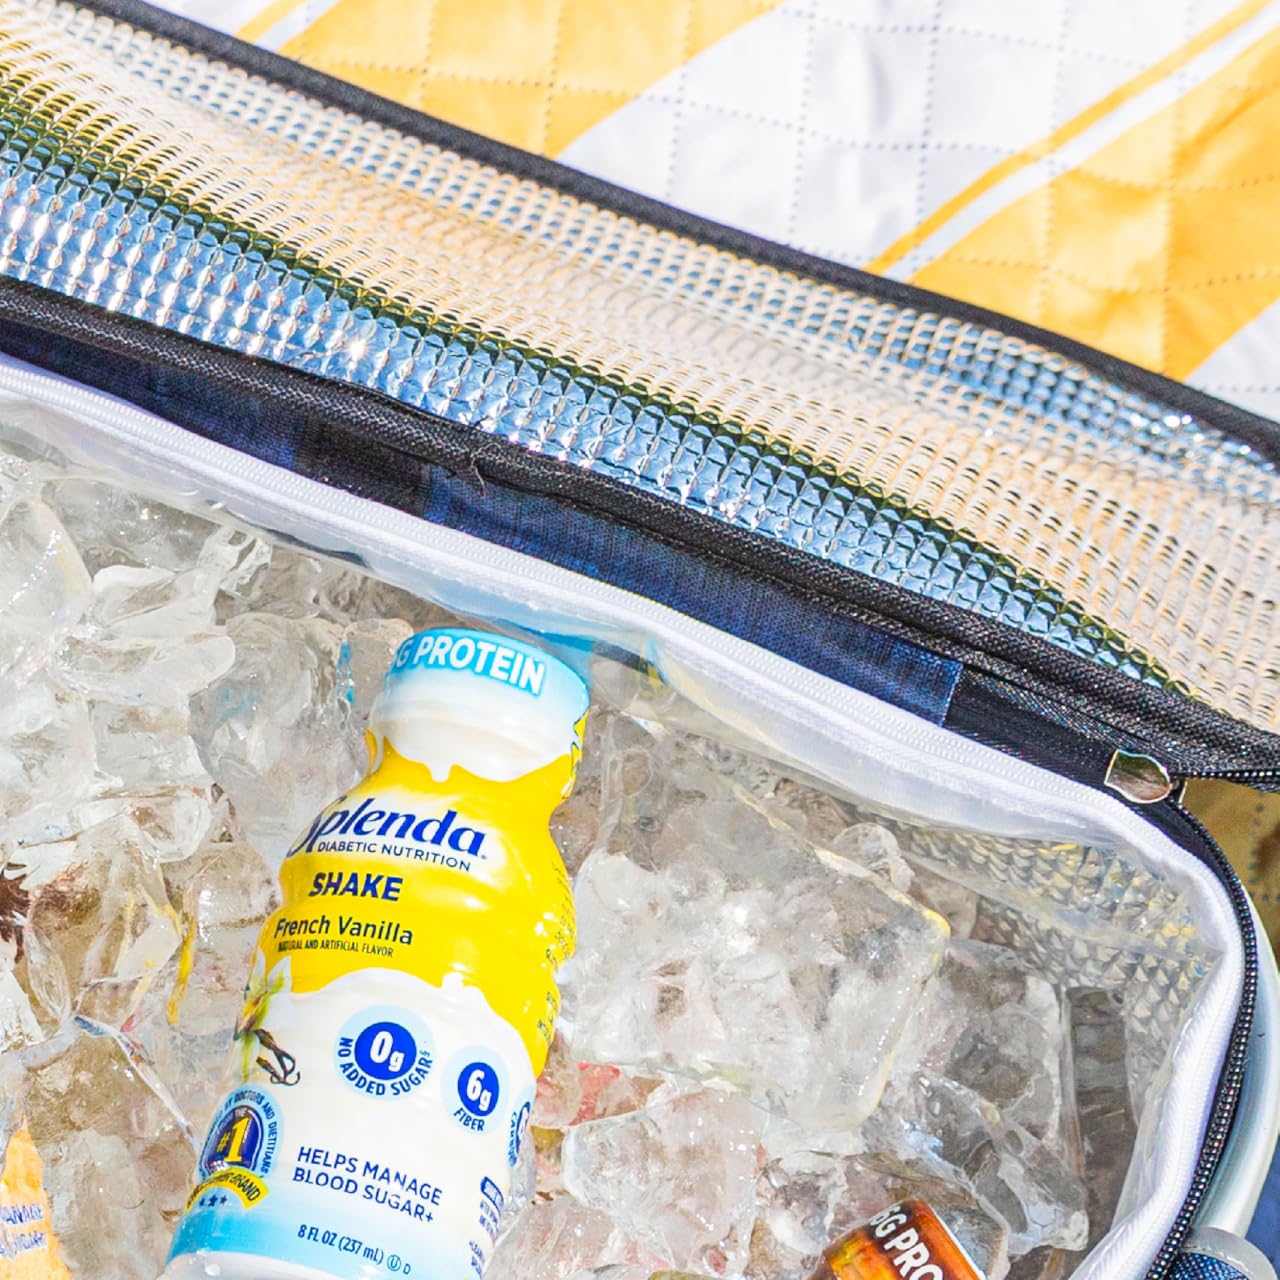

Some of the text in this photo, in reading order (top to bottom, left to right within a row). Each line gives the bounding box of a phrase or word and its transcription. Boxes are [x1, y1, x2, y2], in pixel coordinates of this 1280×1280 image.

[413, 635, 545, 696] PROTEIN
[319, 841, 471, 872] DIABETIC NUTRITION
[309, 872, 404, 902] SHAKE
[274, 915, 414, 946] French Vanilla
[320, 939, 394, 958] ARTIFICIAL FLAVOR
[337, 1037, 386, 1096] NO ADDED
[370, 1030, 405, 1073] 0g
[466, 1069, 492, 1112] 6g
[217, 1116, 249, 1163] #1
[453, 1107, 485, 1132] FIBER
[260, 1121, 277, 1174] DIETITIANS
[292, 1167, 434, 1223] BLOOD SUGAR+
[297, 1146, 358, 1173] HELPS
[362, 1161, 443, 1206] MANAGE
[297, 1224, 384, 1266] 8 FL OZ (237 mL)
